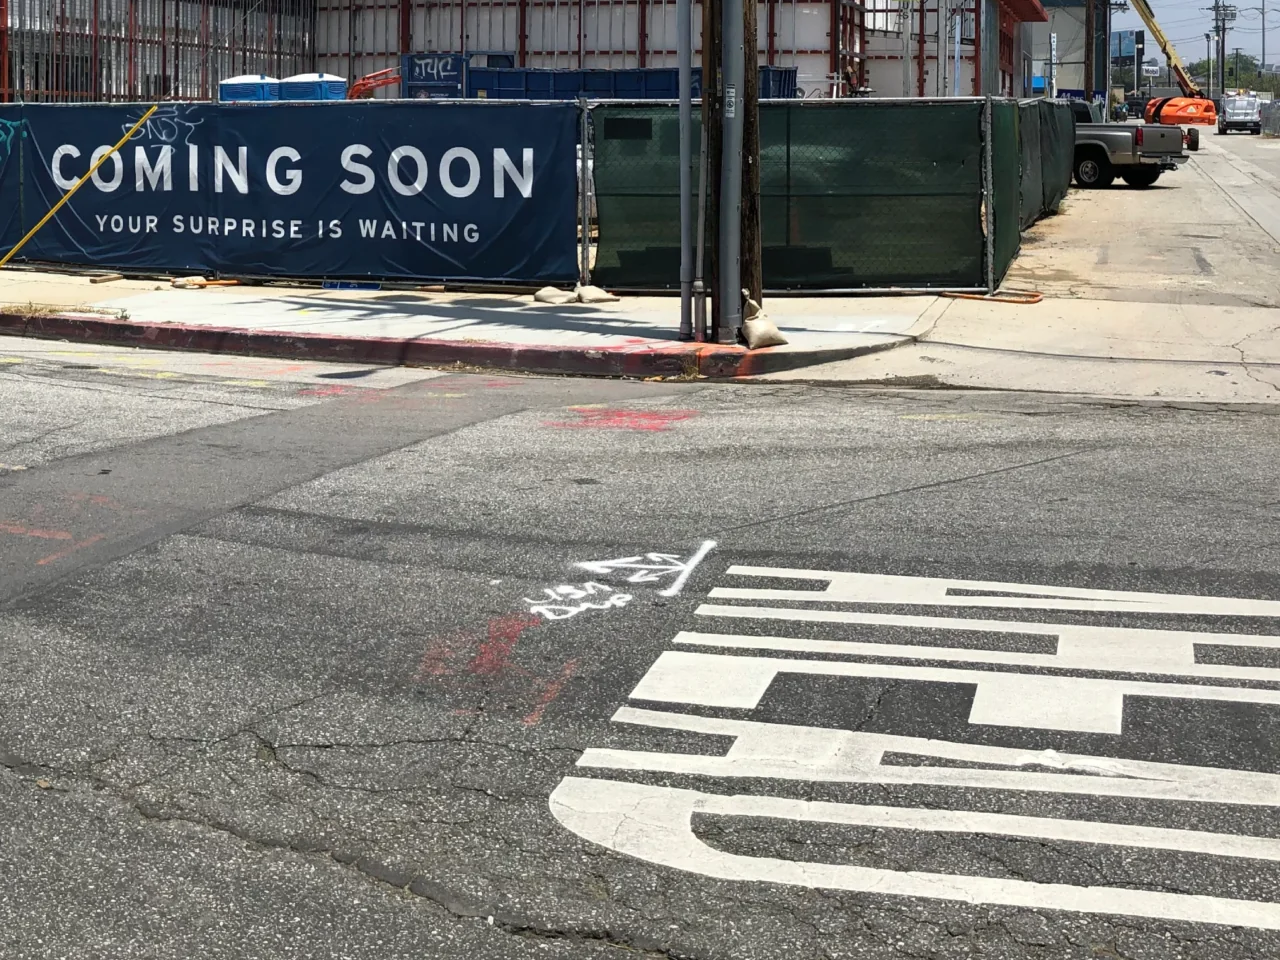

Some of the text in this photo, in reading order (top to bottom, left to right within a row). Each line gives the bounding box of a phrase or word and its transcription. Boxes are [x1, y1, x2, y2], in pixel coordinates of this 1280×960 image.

[51, 142, 534, 198] COMING SOON
[95, 214, 480, 243] YOUR SURPRISE IS WAITING
